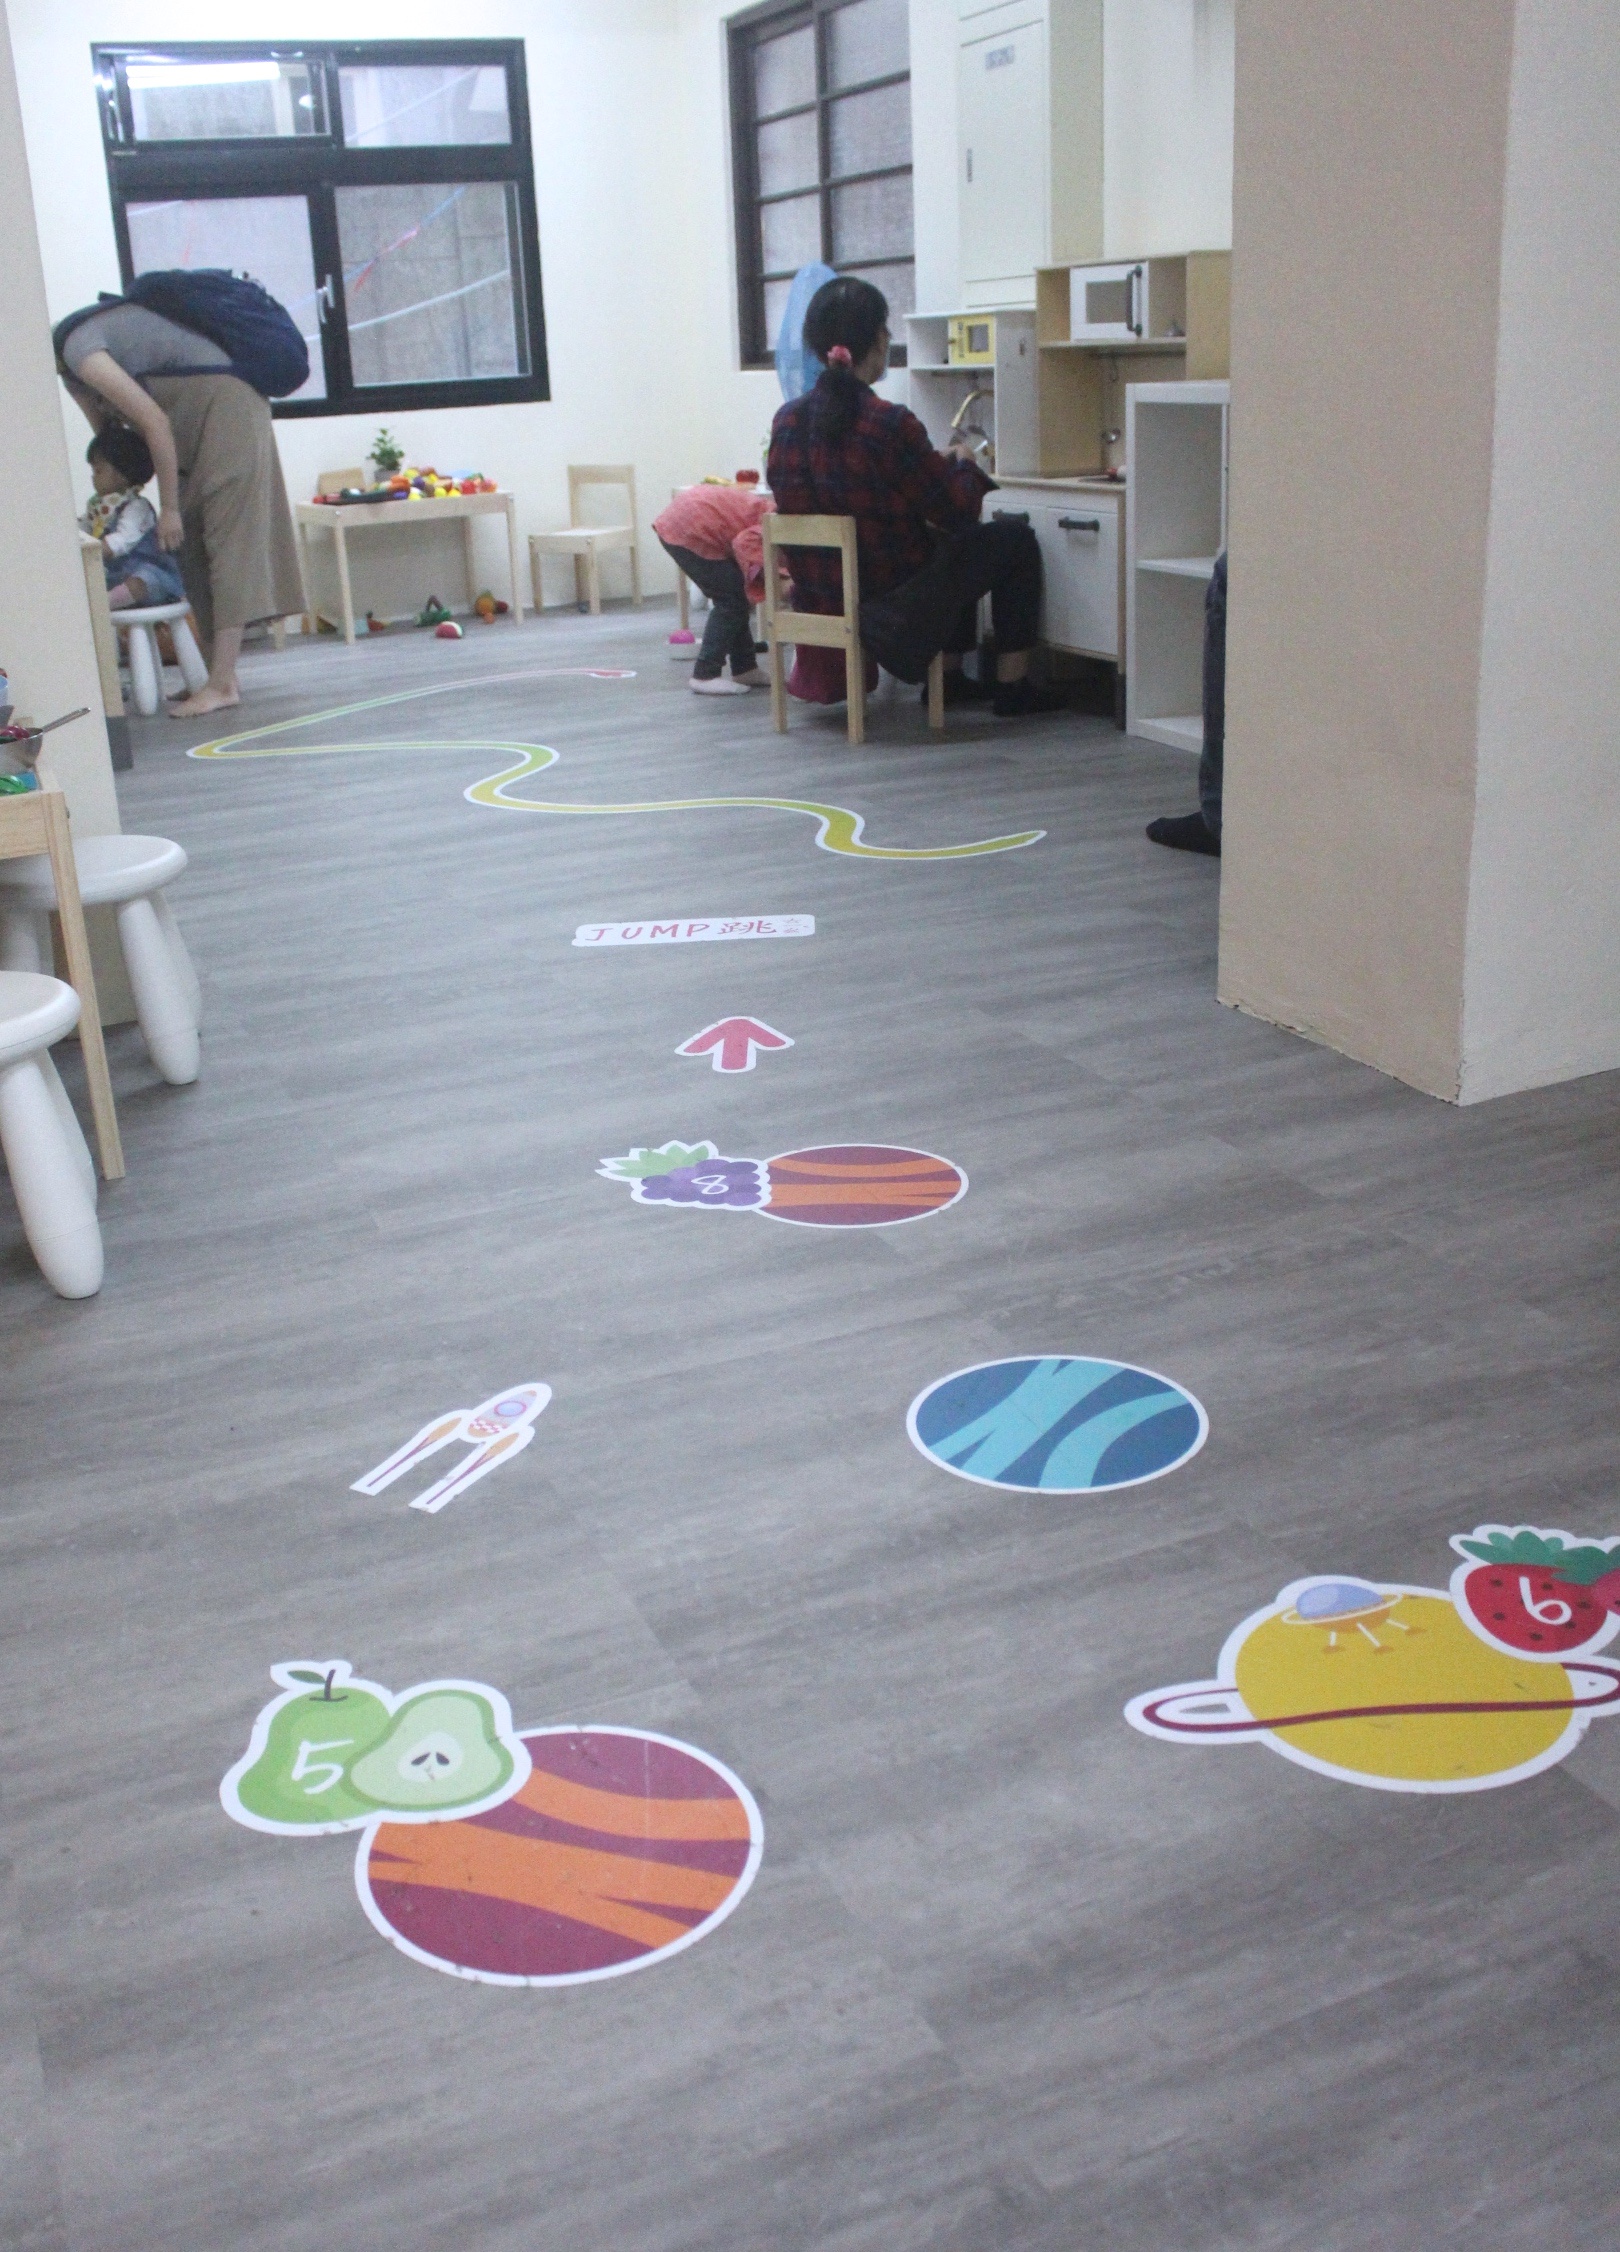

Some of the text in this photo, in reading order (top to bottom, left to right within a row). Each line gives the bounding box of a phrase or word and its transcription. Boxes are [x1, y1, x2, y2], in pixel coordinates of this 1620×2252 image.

[585, 923, 710, 941] JUMP
[717, 919, 777, 935] 跳
[691, 1174, 729, 1195] 8
[1519, 1576, 1572, 1625] 6
[291, 1739, 354, 1795] 5
